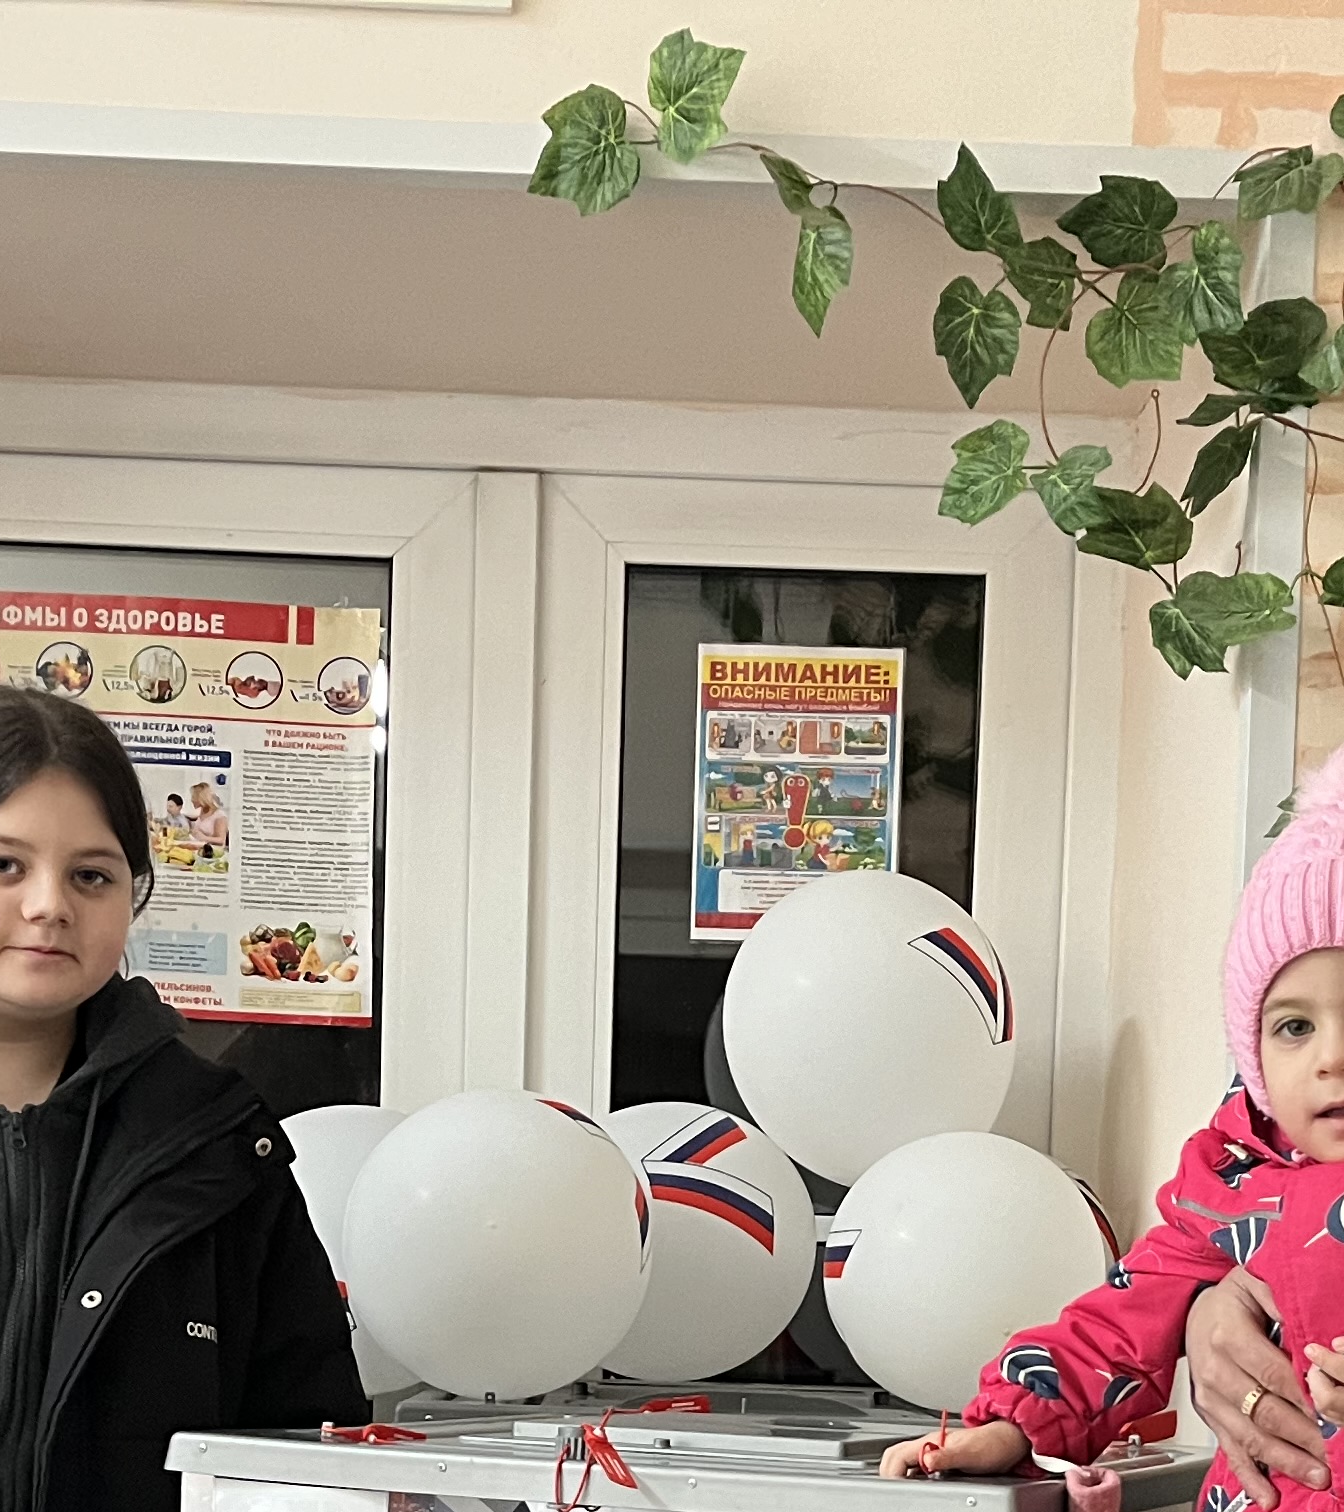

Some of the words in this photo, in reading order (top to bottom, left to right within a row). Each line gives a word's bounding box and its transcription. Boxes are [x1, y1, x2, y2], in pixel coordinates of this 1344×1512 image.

[73, 606, 87, 628] О
[95, 608, 225, 635] ЗДОРОВЬЕ
[709, 661, 890, 685] ВНИМАНИЕ:
[709, 685, 790, 700] ОПАСНЫЕ
[795, 687, 890, 703] ПРЕДМЕТЫ!
[142, 722, 180, 732] ВСЕГДА
[182, 723, 216, 735] ГОРОЙ,
[265, 728, 282, 737] ЧТО
[283, 729, 321, 740] ДОЛЖНО
[322, 731, 347, 740] БЫТЬ
[120, 733, 186, 745] ПРАВИЛЬНОЙ
[271, 740, 304, 749] ВАШЕМ
[127, 750, 187, 760] олноценной
[153, 981, 215, 994] ПЕЛЬСИНОВ.
